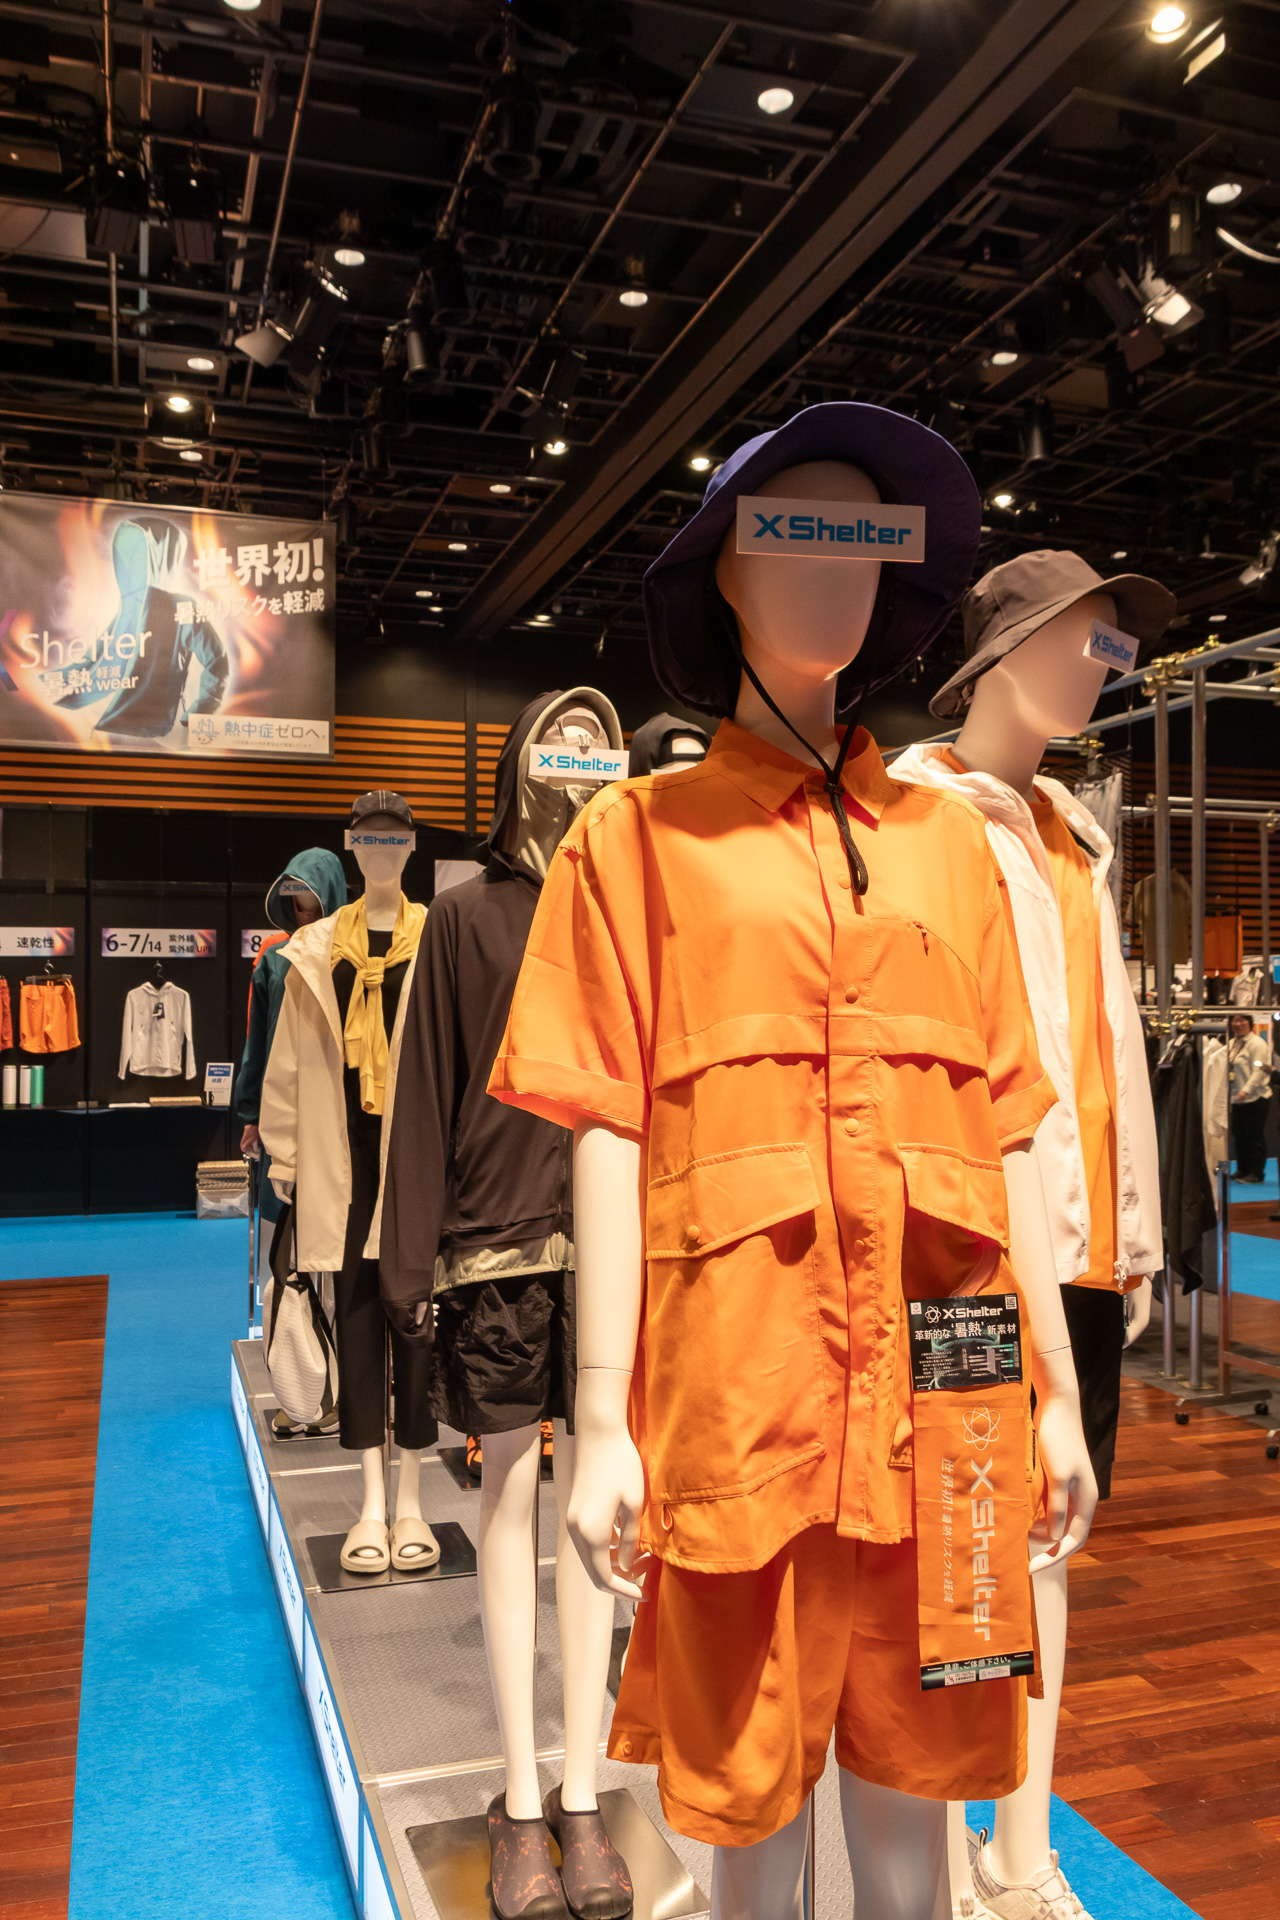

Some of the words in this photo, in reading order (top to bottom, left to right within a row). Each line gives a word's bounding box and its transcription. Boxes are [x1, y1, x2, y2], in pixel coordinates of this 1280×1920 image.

[97, 676, 139, 691] wear
[16, 936, 55, 949] 速乾性
